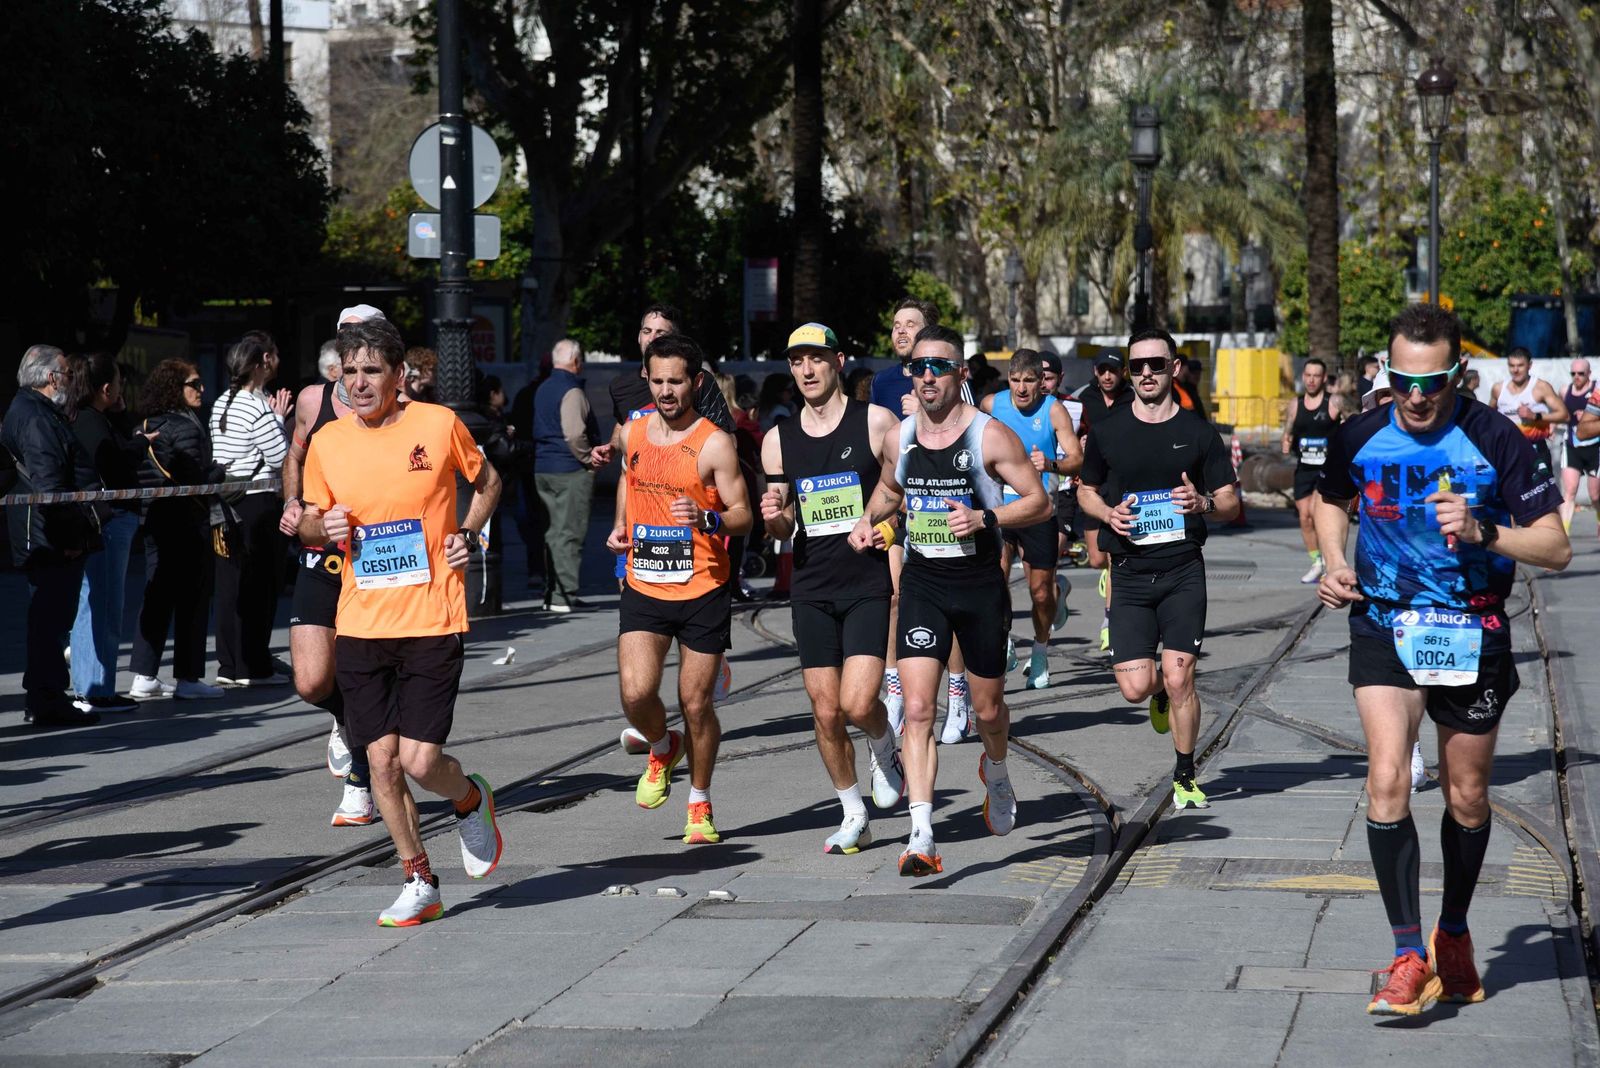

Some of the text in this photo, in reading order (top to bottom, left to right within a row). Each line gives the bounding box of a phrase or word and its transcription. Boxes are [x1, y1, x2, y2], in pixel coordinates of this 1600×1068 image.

[817, 475, 852, 488] ZURICH
[926, 478, 967, 486] ATLETISMO
[930, 488, 974, 496] TORREVIEJA
[821, 495, 840, 505] 3083
[811, 505, 854, 522] ALBERT
[1144, 509, 1162, 517] 6431
[928, 518, 947, 527] 2204
[1136, 518, 1173, 533] BRUNO
[370, 522, 412, 537] ZURICH
[650, 529, 684, 537] ZURICH
[375, 545, 396, 555] 9441
[651, 546, 669, 554] 4202
[362, 554, 418, 573] CESITAR
[633, 558, 693, 570] SERGIO Y VIR
[1425, 612, 1472, 625] ZURICH
[1424, 635, 1450, 646] 5615
[1416, 650, 1456, 666] COCA
